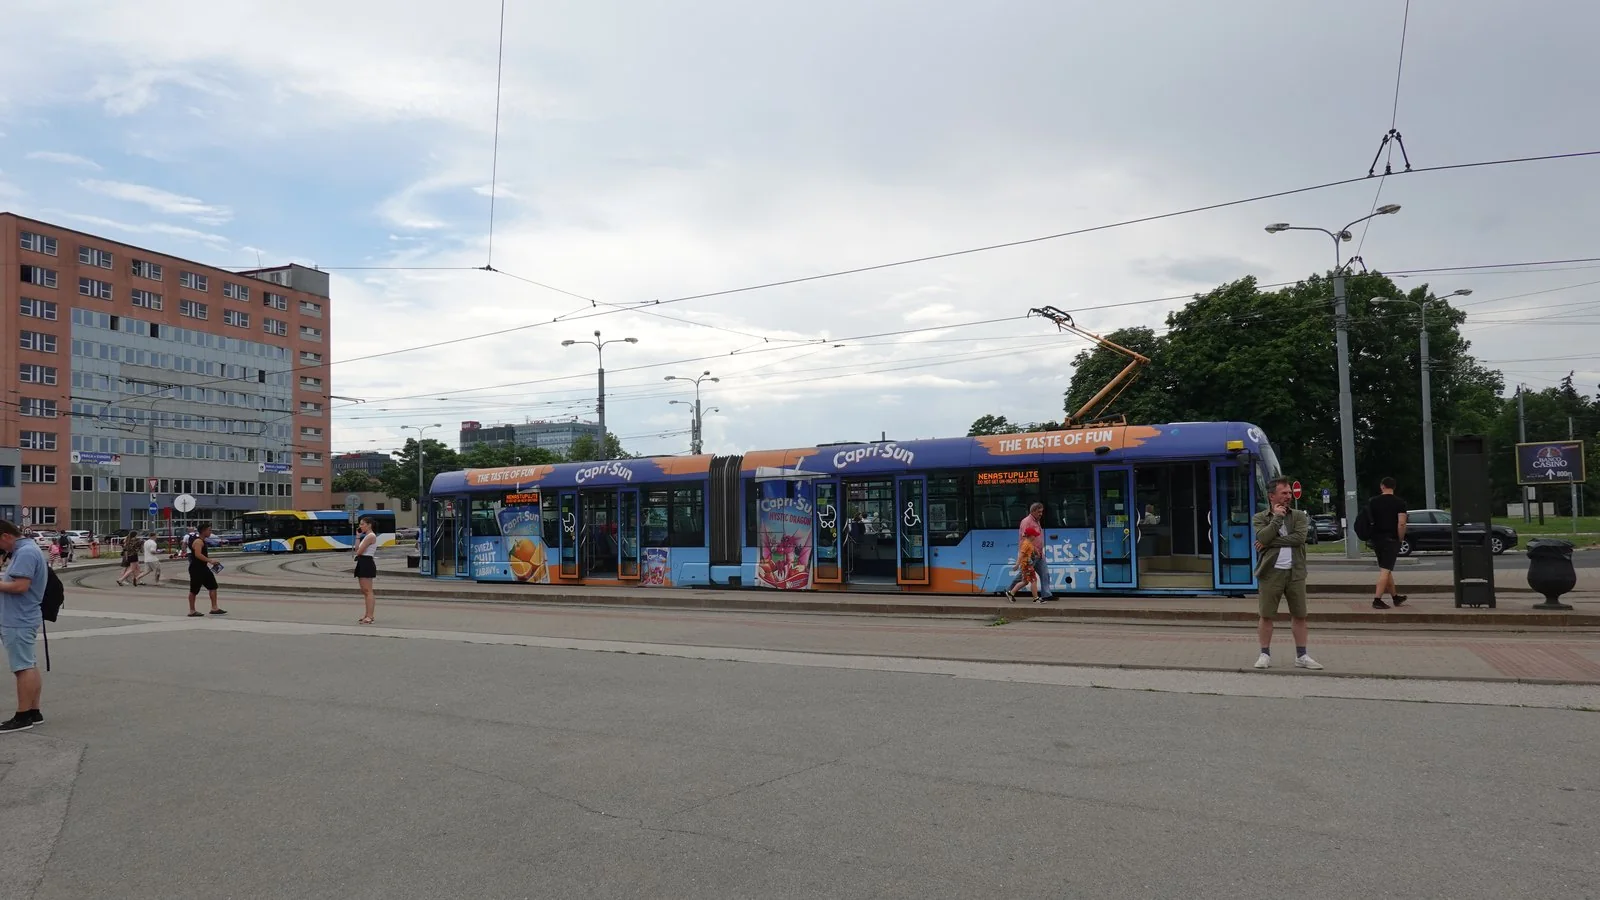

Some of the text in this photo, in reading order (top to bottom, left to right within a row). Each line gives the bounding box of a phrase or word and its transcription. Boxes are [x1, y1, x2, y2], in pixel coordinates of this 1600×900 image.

[999, 430, 1113, 452] THE TASTE OF FUN
[833, 443, 915, 469] Capri-Sun
[1532, 460, 1568, 468] CASINO
[477, 467, 536, 484] THE TASTE OF FUN
[575, 461, 633, 484] Capri-Sun
[978, 471, 1039, 480] NENASTUPUJTE
[761, 497, 812, 514] Capri-Su
[503, 510, 540, 534] Capri-Sun
[981, 540, 994, 548] 823
